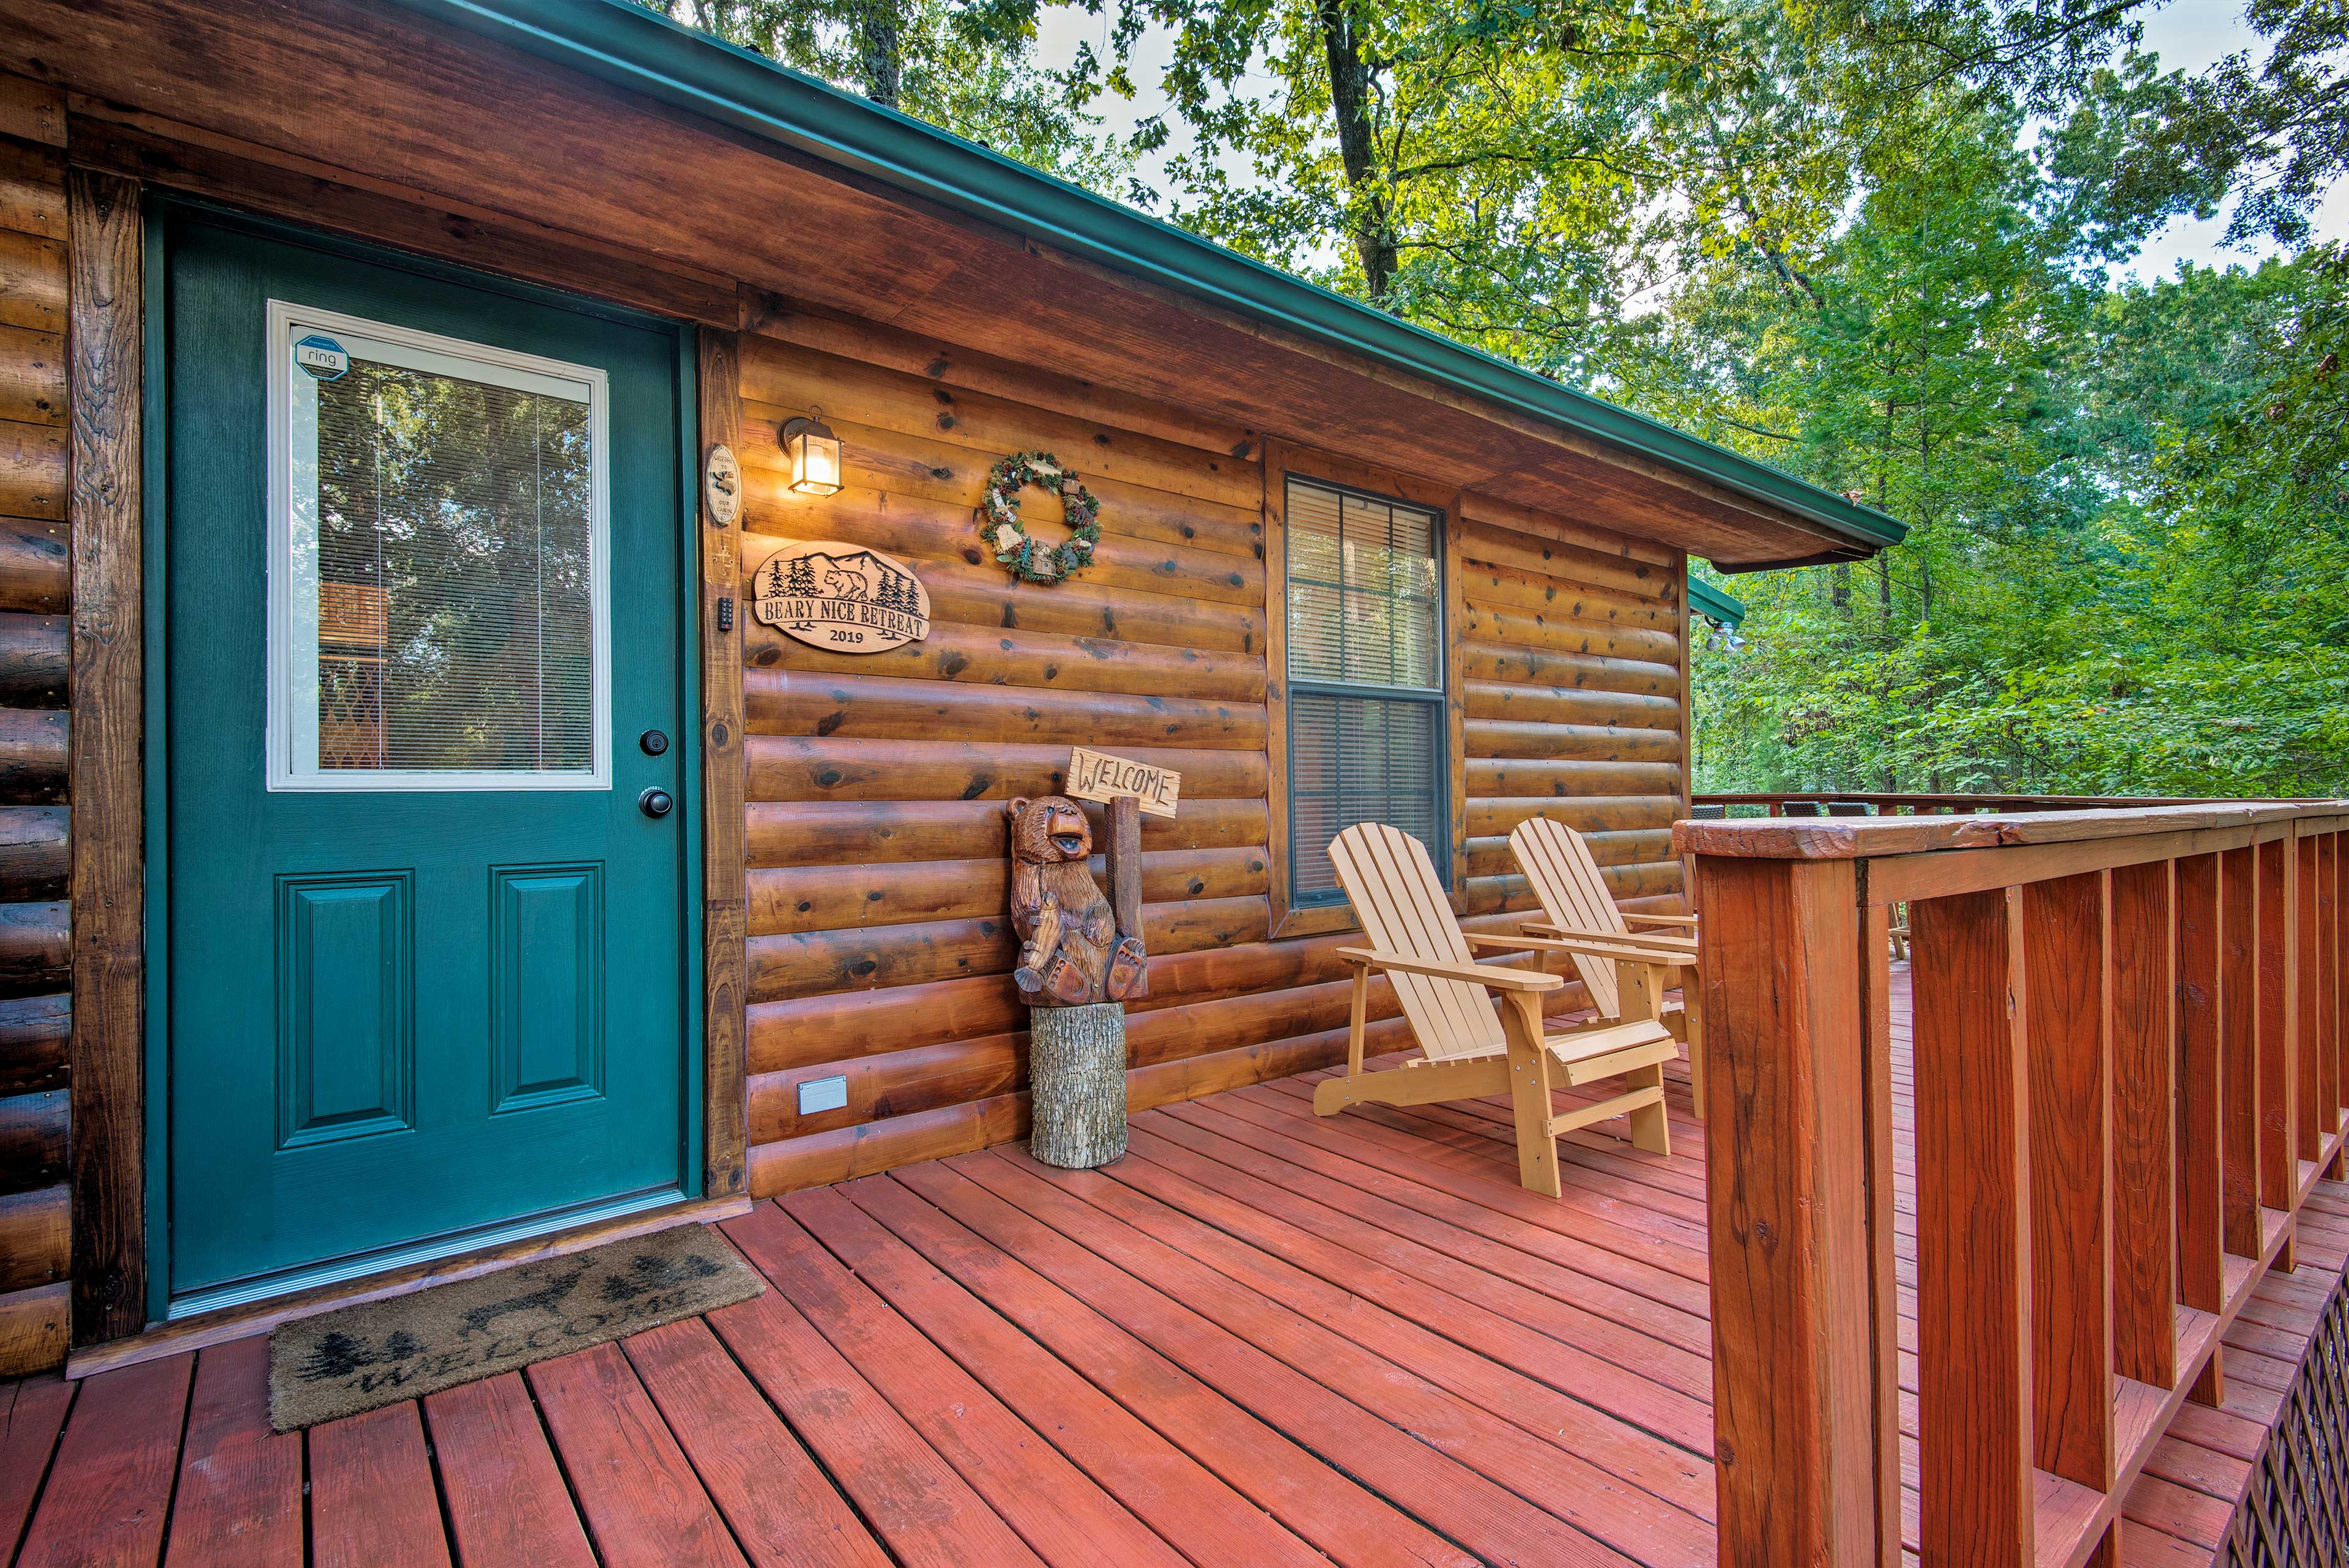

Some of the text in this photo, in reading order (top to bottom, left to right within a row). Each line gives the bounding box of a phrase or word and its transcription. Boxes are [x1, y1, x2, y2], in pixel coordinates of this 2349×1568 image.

[308, 350, 336, 367] ring
[765, 600, 922, 637] BEARY NICE RETREAT
[829, 630, 864, 644] 2019
[1078, 752, 1175, 806] WELCOME
